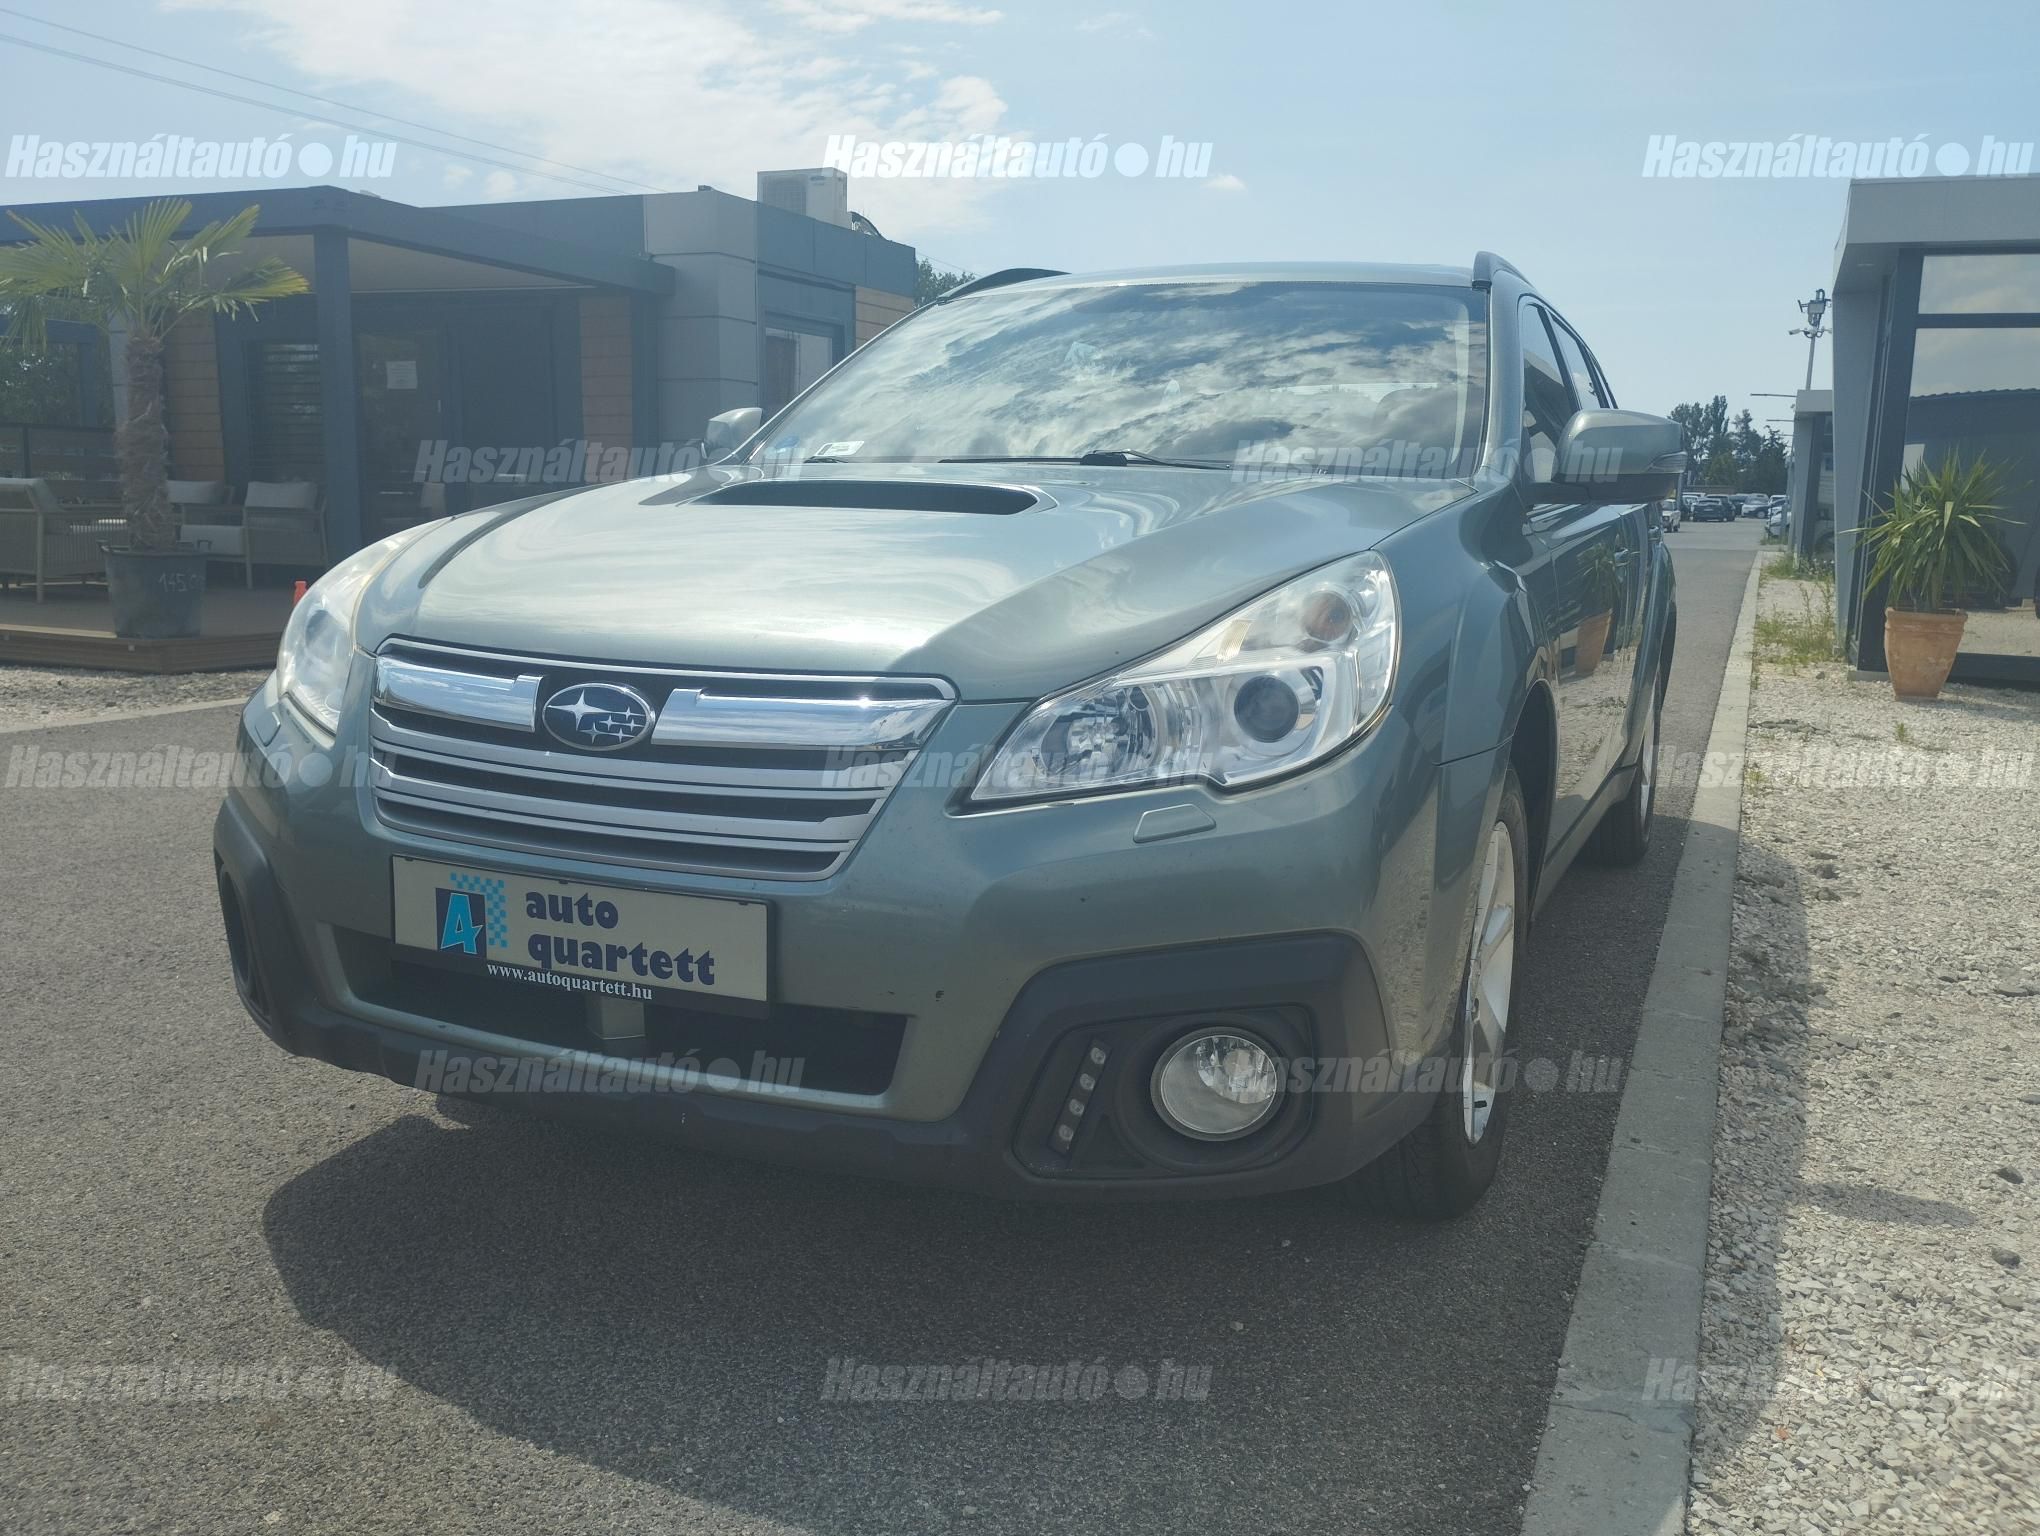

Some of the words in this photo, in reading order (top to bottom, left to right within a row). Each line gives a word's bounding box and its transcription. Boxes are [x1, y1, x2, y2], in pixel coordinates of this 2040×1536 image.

[525, 891, 619, 930] auto
[527, 933, 716, 986] quartett
[486, 963, 653, 1000] www.autoquartett.hu
